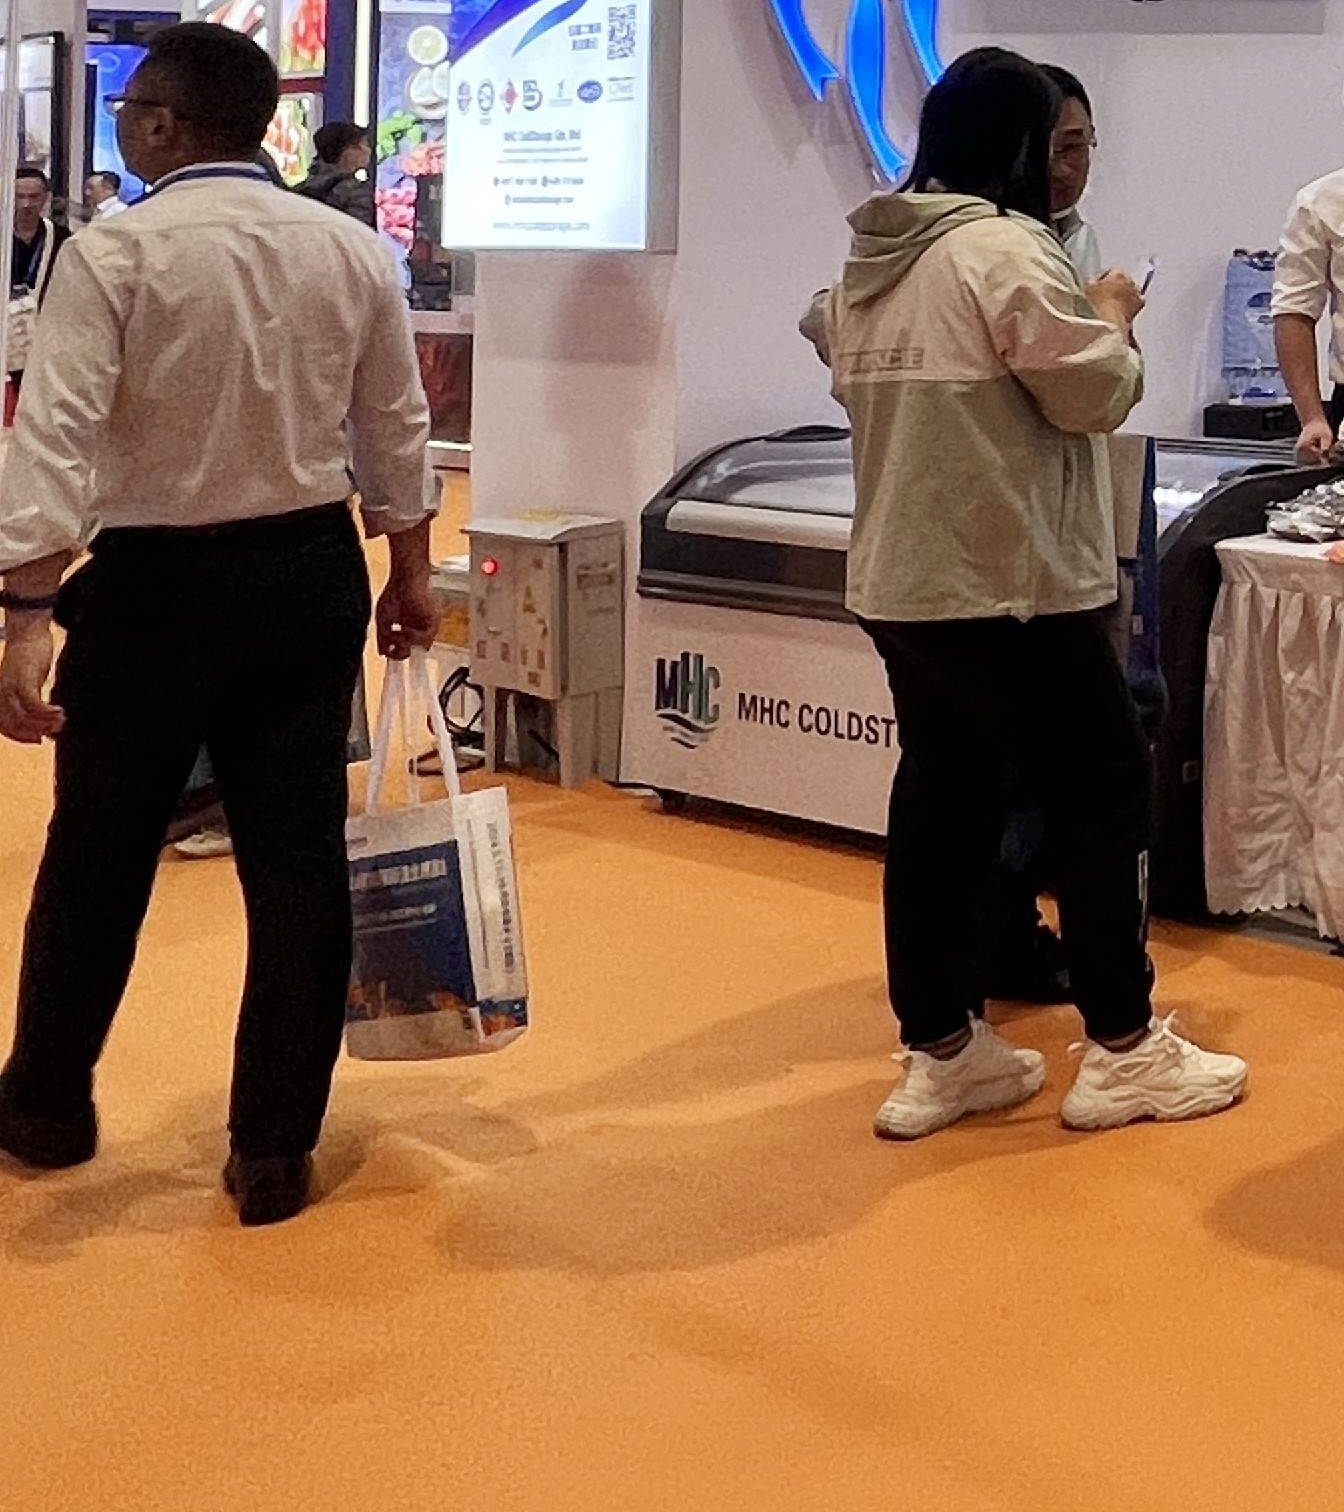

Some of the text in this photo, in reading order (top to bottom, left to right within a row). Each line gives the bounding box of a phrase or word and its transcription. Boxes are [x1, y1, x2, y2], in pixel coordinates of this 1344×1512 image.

[654, 651, 721, 725] MHC
[738, 692, 897, 748] MHC COLDST
